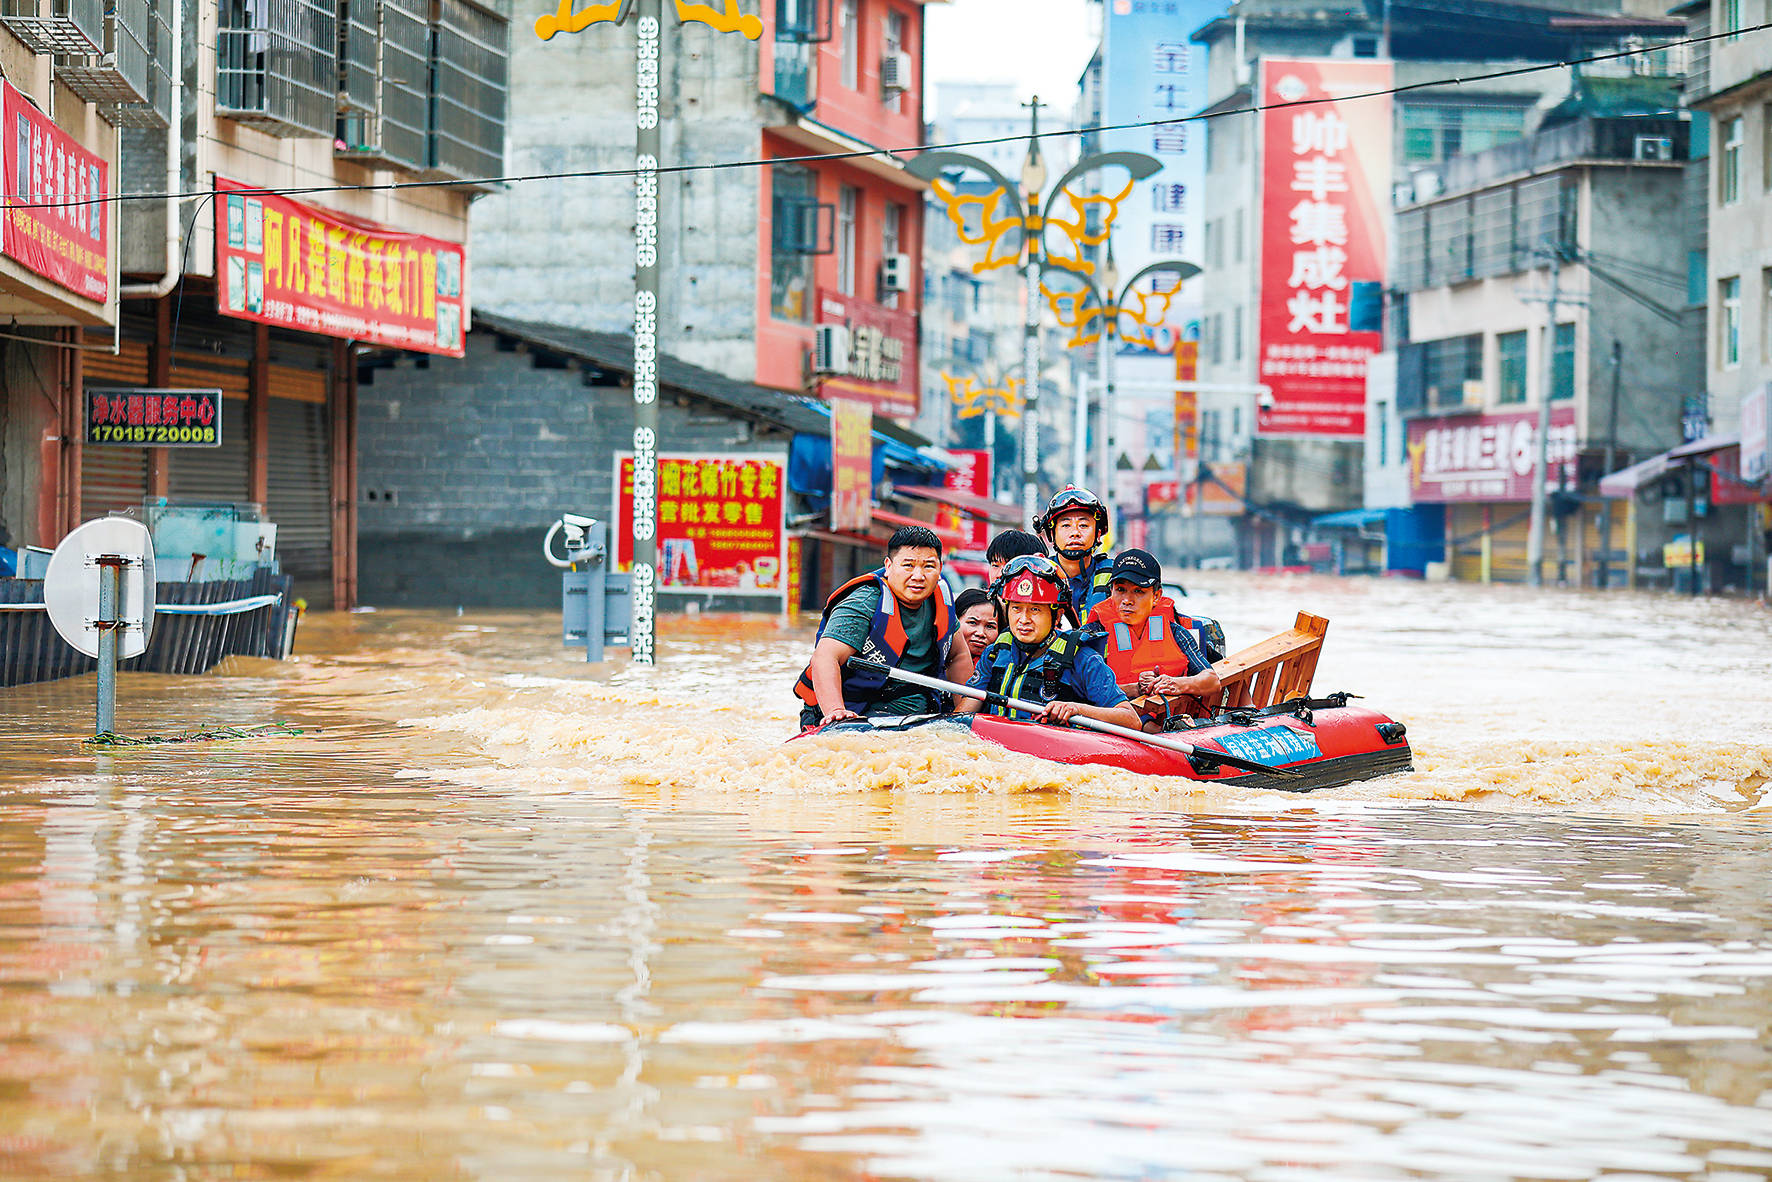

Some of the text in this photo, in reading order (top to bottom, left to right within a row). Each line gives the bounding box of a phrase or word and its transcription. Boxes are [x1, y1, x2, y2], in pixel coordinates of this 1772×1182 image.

[1286, 111, 1348, 334] 帅丰集成灶
[93, 394, 215, 425] 净水器服务中心
[92, 426, 215, 442] 17018720008
[623, 462, 777, 498] 烟花爆竹专卖
